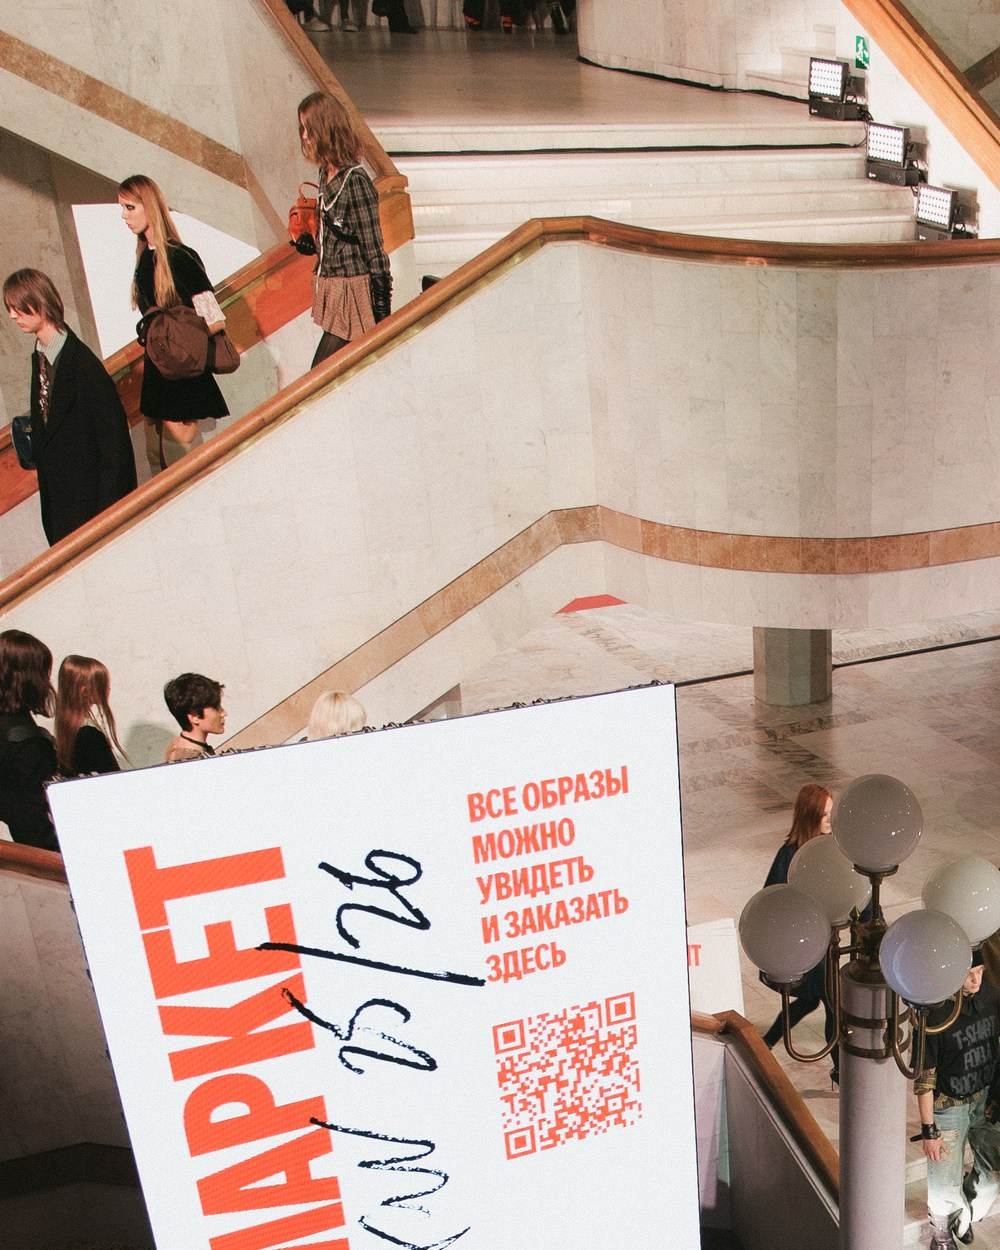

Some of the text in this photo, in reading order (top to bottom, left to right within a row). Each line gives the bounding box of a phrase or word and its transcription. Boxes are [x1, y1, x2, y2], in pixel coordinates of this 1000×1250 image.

[467, 765, 630, 823] ВСЕ ОБРАЗЫ
[471, 817, 576, 865] МОЖНО
[475, 855, 595, 906] УВИДЕТЬ
[481, 888, 630, 945] И ЗАКАЗАТЬ
[255, 848, 487, 1076] 25/26
[485, 941, 567, 984] ЗДЕСЬ
